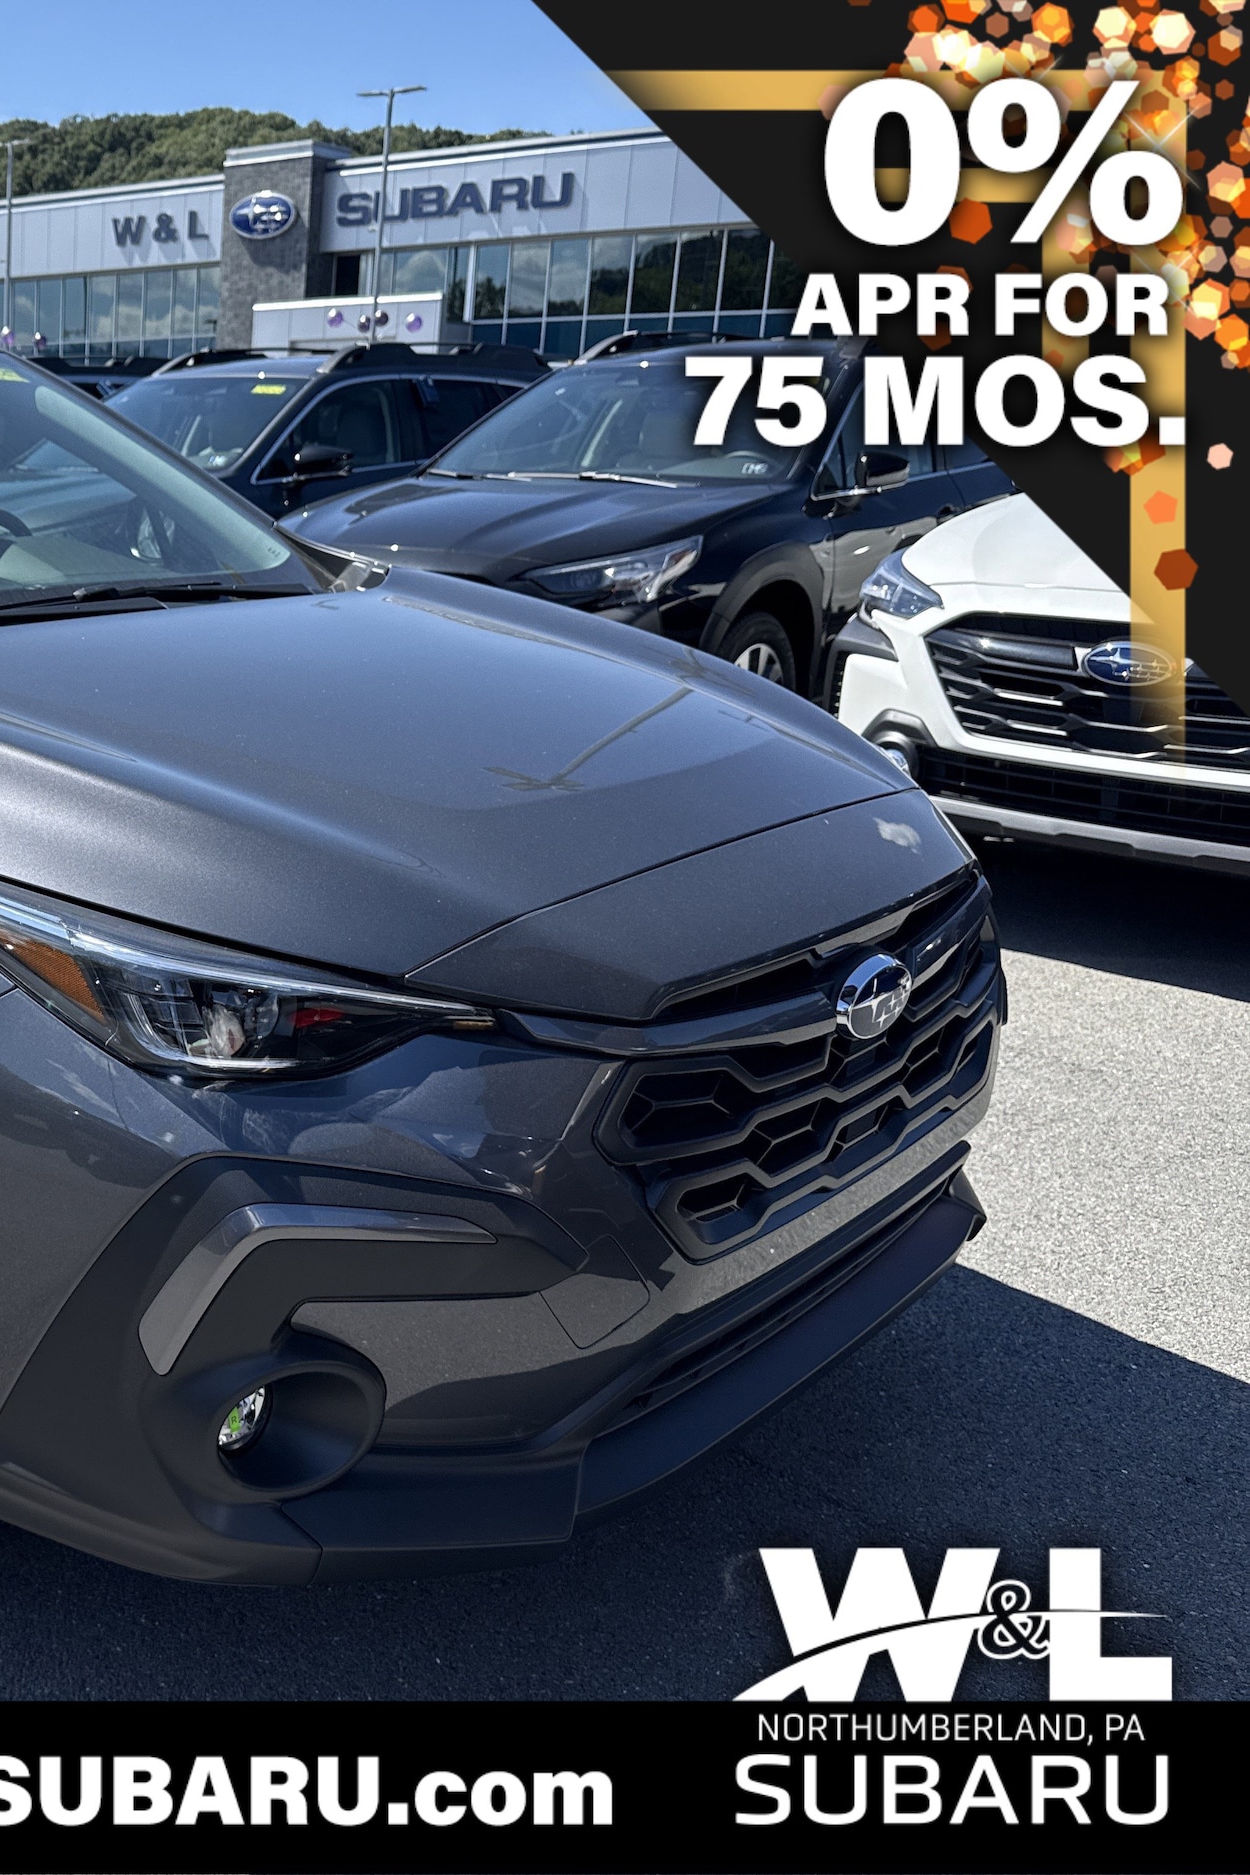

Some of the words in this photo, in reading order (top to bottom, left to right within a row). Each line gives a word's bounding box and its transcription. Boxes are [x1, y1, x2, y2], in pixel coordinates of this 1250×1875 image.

[336, 172, 575, 228] SUBARU
[111, 214, 147, 248] W
[152, 212, 180, 244] &
[188, 210, 210, 241] L
